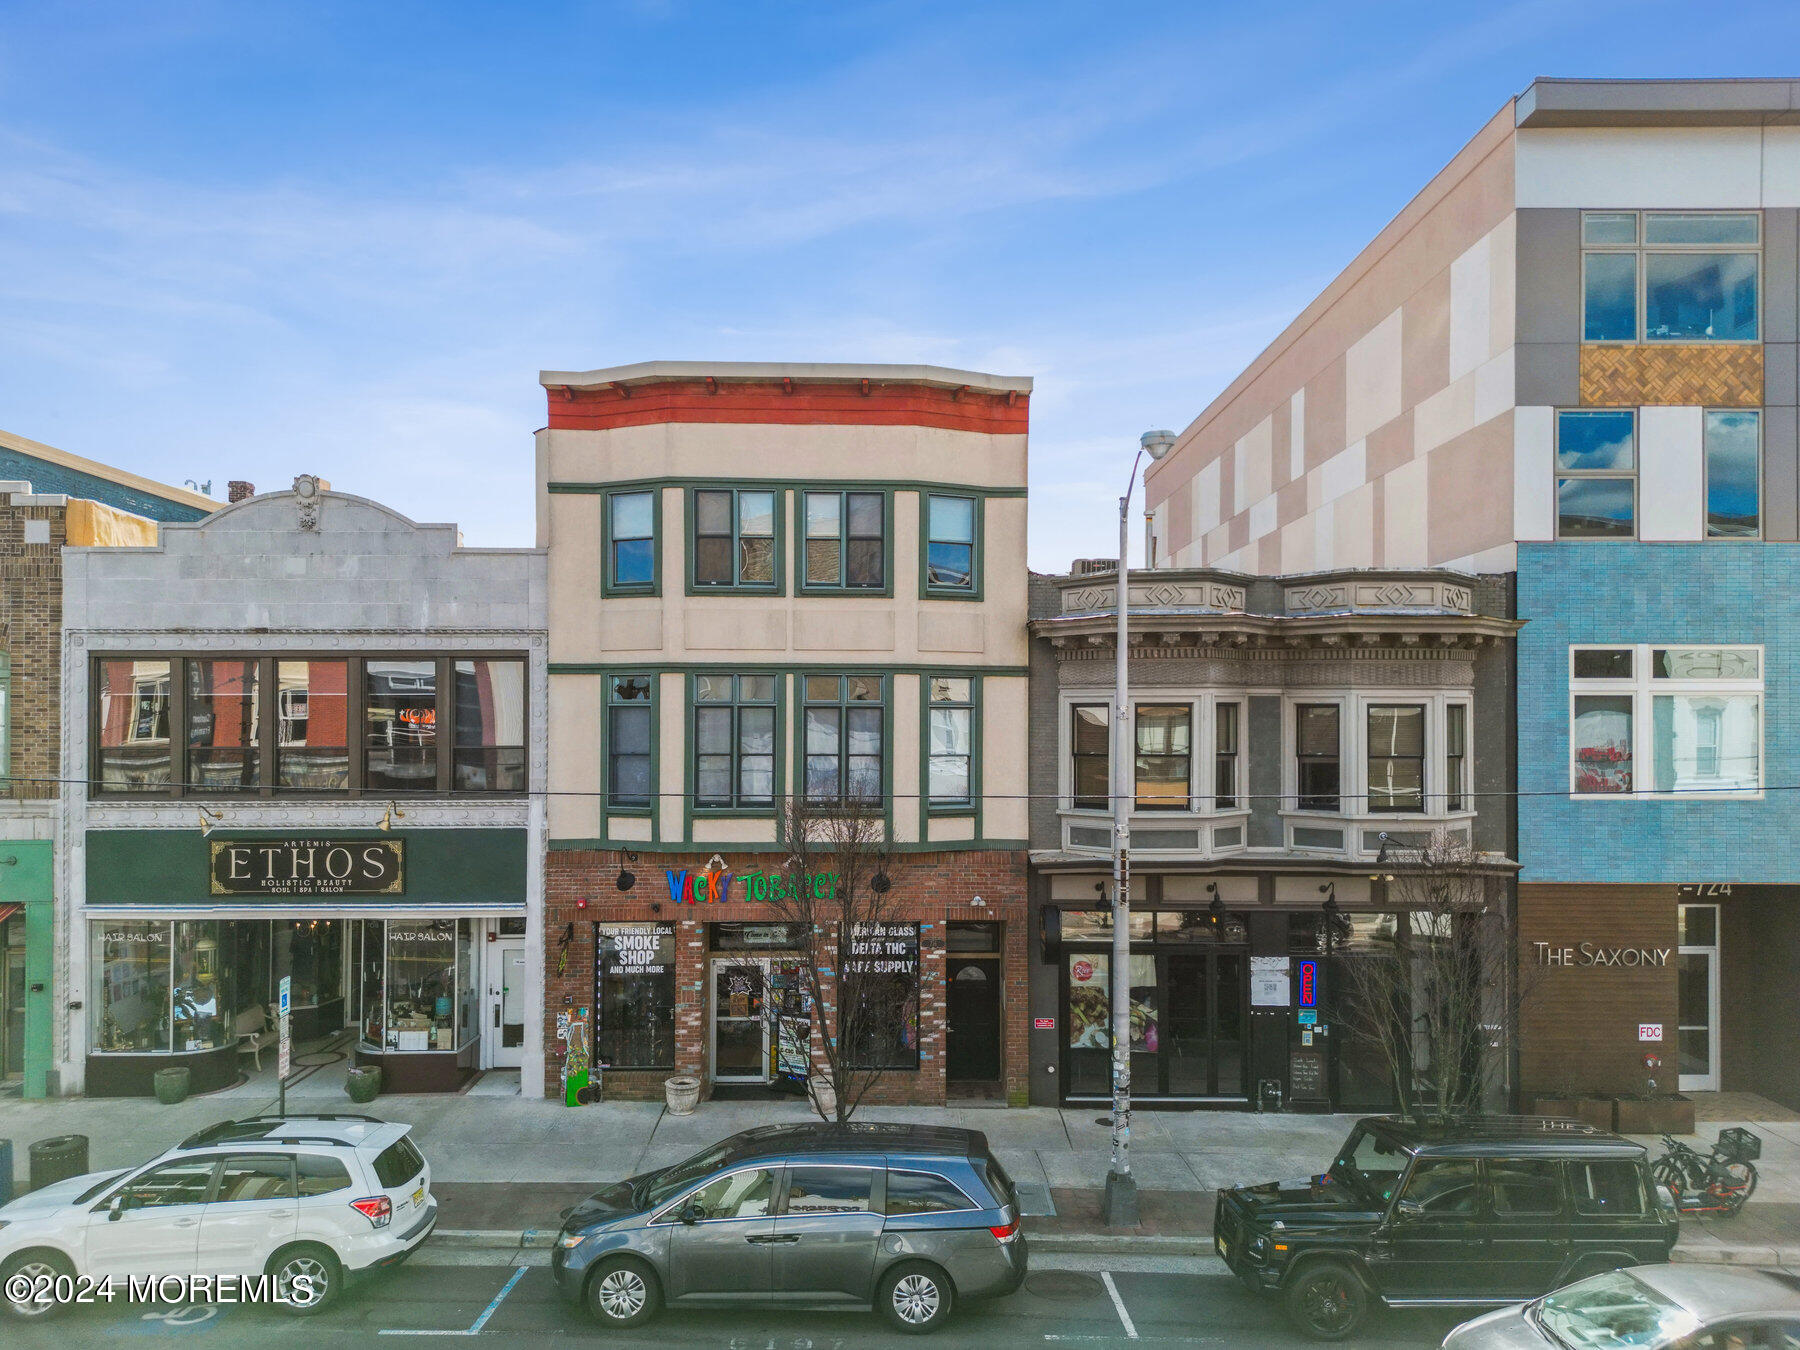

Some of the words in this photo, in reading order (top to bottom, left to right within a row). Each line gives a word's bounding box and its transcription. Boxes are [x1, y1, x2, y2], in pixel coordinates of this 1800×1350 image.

[229, 847, 385, 879] ETHOS
[666, 869, 734, 904] WACKY
[388, 932, 416, 941] HAIR
[417, 932, 453, 941] SALON
[602, 927, 620, 935] YOUR
[621, 927, 650, 935] FRIENDLY
[653, 926, 672, 934] LOCAL
[97, 933, 124, 942] HAIR
[126, 933, 162, 942] SALON
[614, 935, 660, 950] SMOKE
[885, 942, 906, 954] THC
[1533, 942, 1574, 966] THE
[1579, 942, 1671, 966] SAXONY
[619, 950, 655, 965] SHOP
[609, 966, 624, 974] AND
[645, 965, 664, 973] MORE
[874, 960, 914, 973] SUPPLY
[1302, 964, 1313, 1004] OPEN
[1640, 1026, 1661, 1038] FDC
